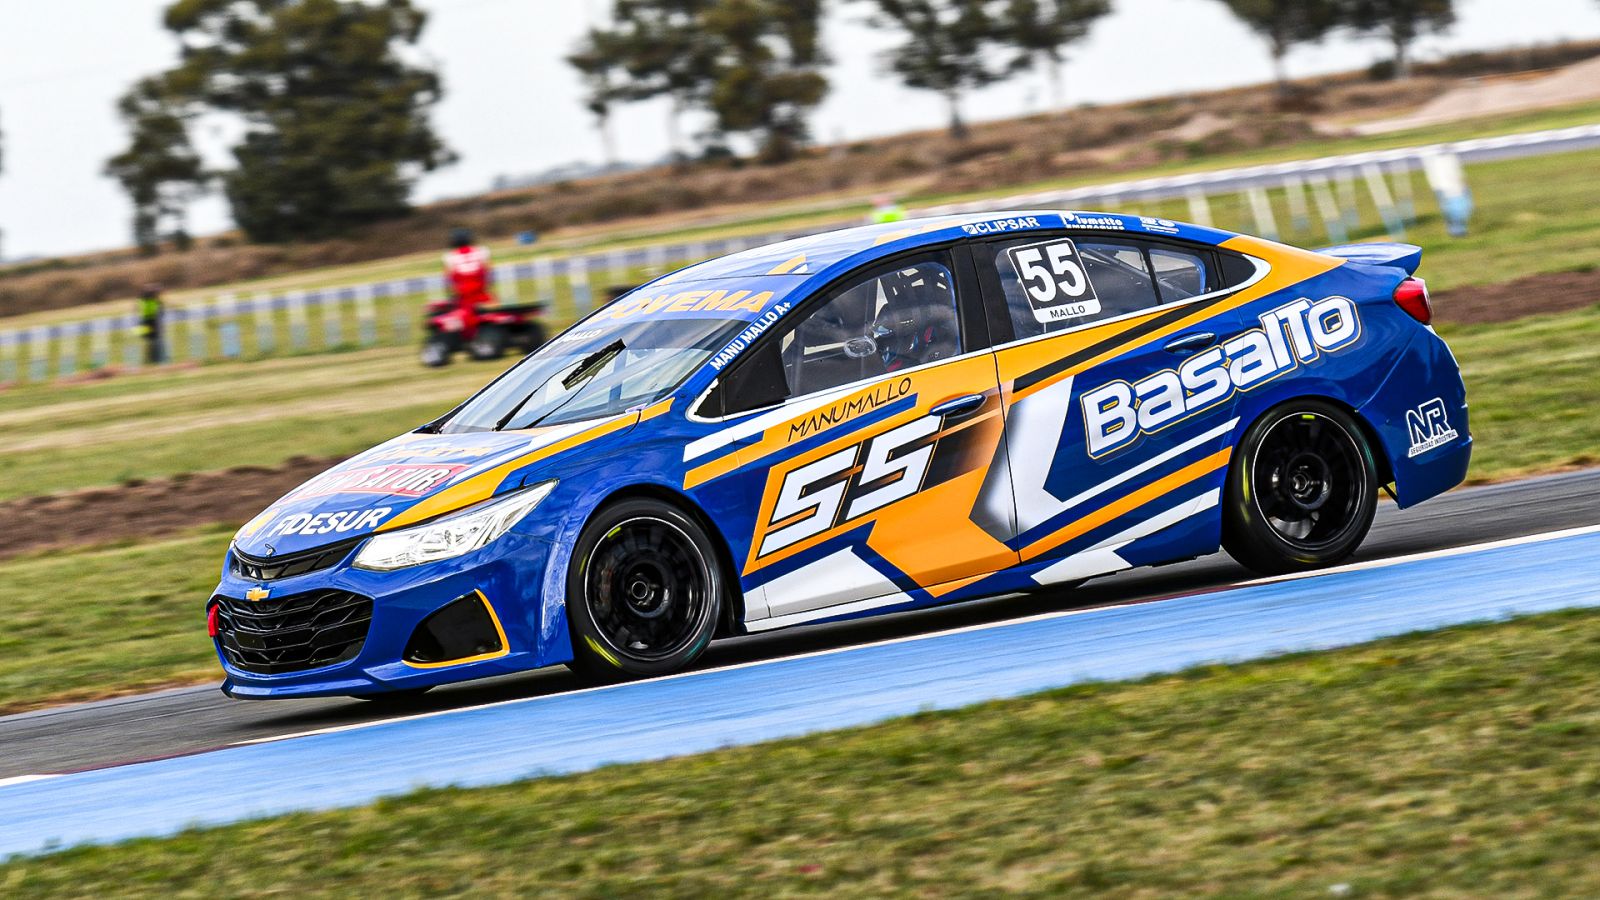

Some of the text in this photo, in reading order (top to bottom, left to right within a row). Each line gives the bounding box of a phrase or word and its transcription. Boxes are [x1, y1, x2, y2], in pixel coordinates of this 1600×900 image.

[975, 217, 1041, 232] CLIPSAR
[1015, 242, 1087, 302] 55
[709, 338, 746, 371] MANU
[740, 311, 778, 344] MALLO
[1050, 304, 1086, 319] MALLO
[787, 376, 912, 443] MANUMALLO
[1406, 397, 1451, 447] NR
[756, 410, 942, 560] 55
